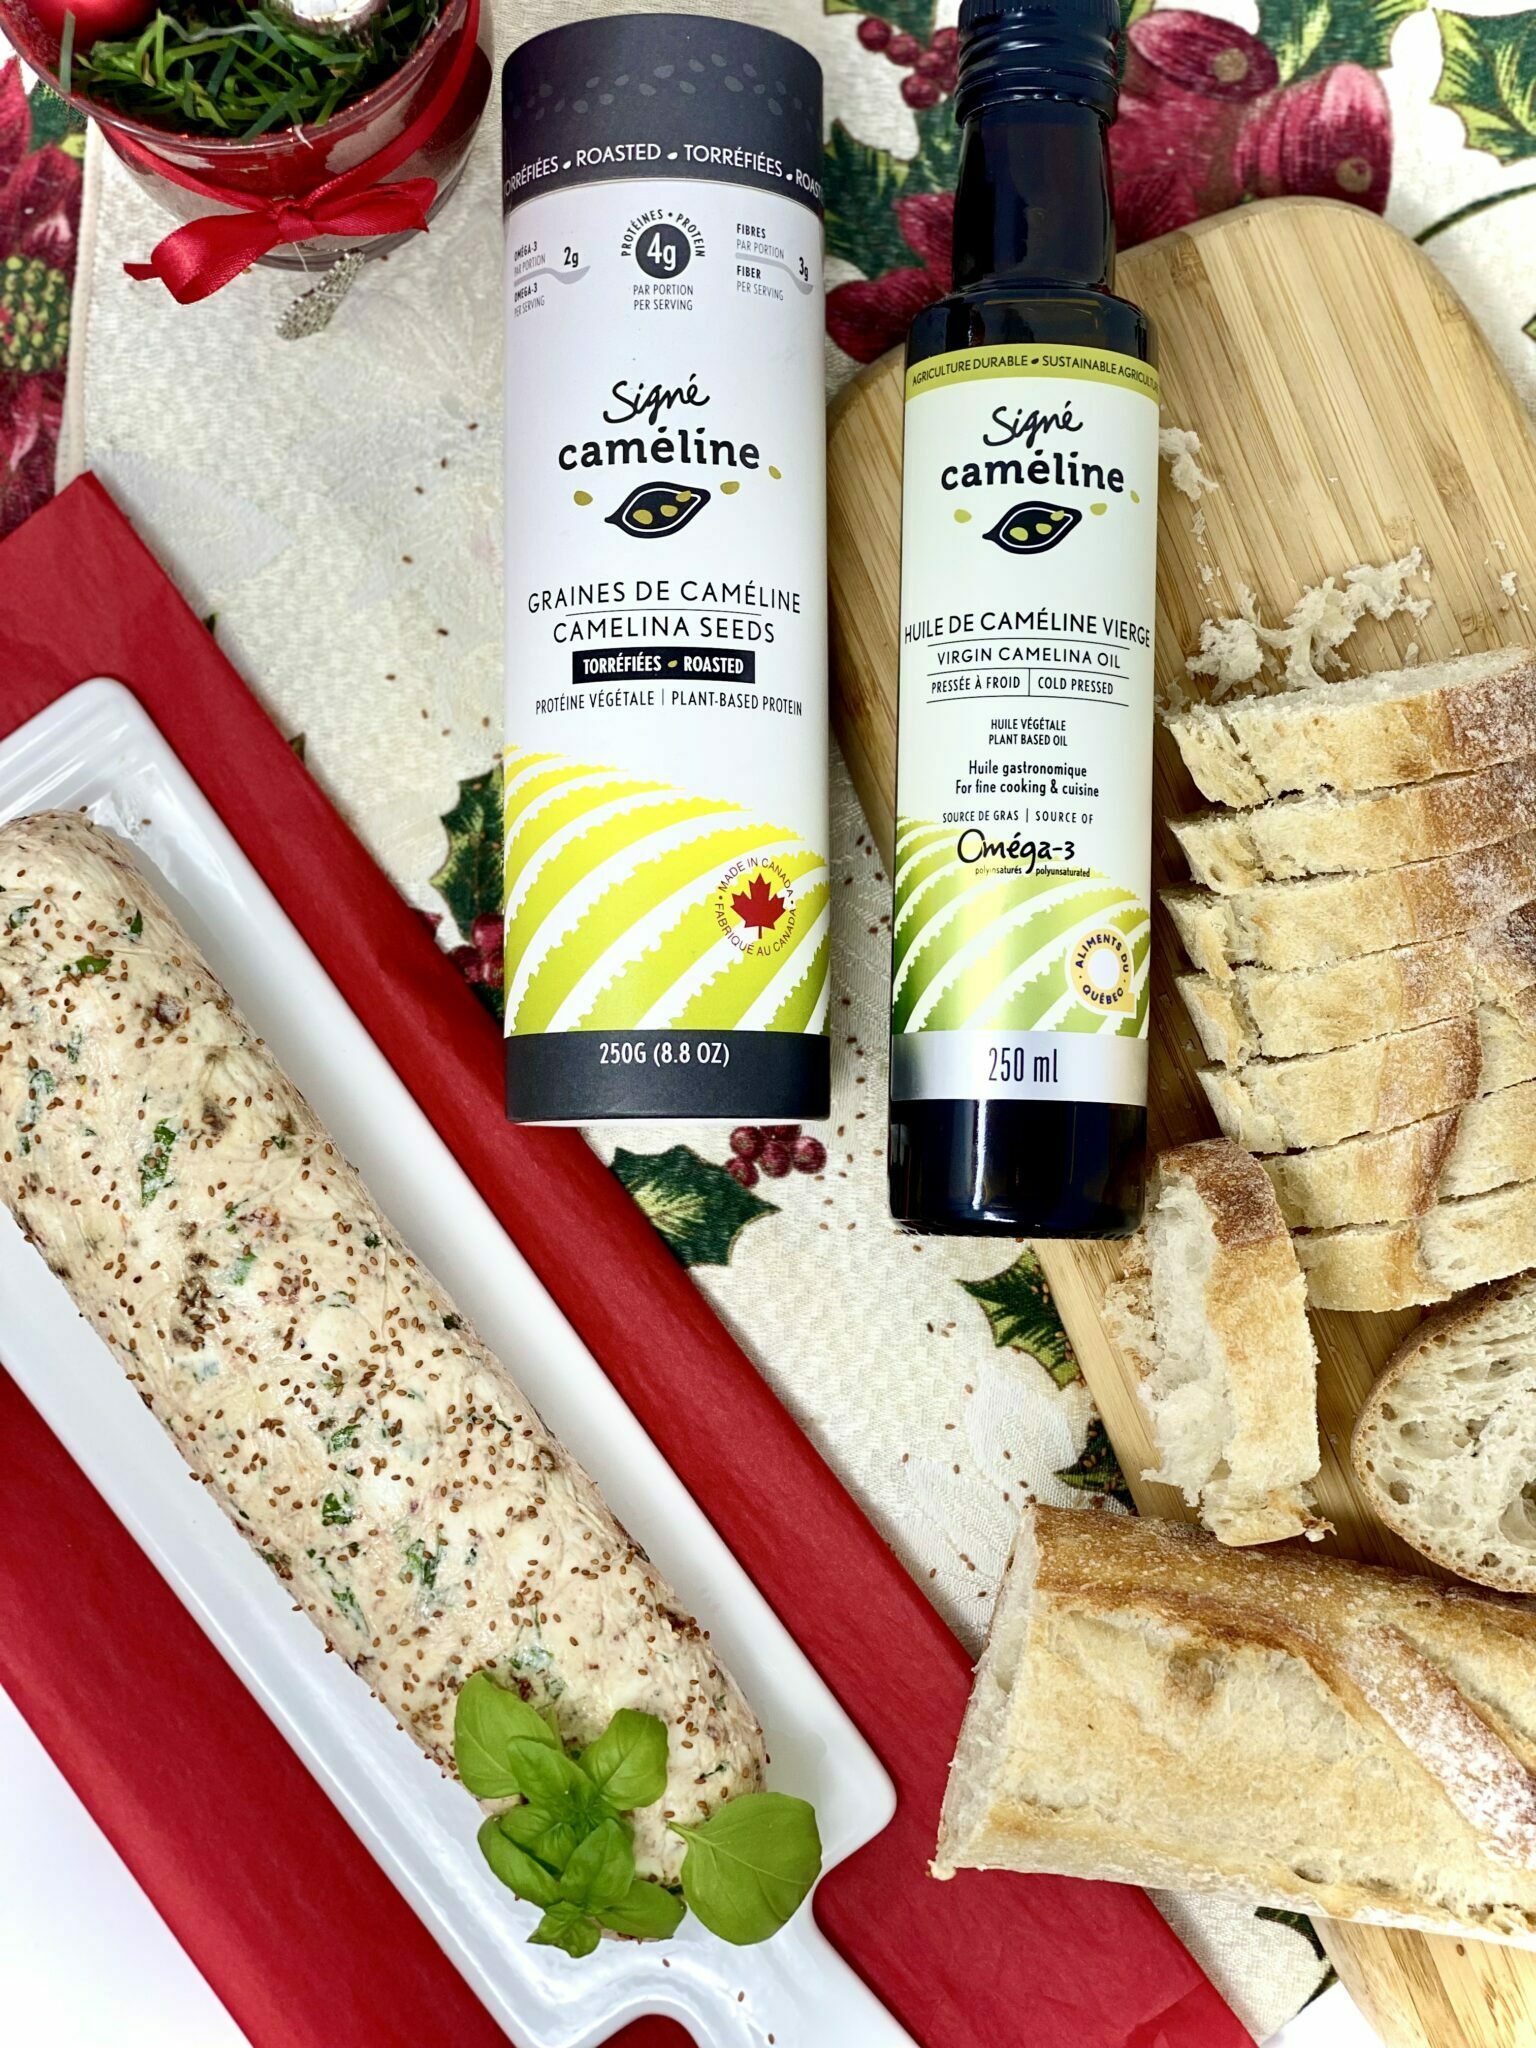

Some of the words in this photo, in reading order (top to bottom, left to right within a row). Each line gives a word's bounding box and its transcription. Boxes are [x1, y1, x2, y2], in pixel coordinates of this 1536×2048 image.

[504, 156, 559, 197] ORRÉFIÉES
[576, 143, 662, 167] ROASTED
[683, 144, 783, 178] TORRÉFIÉES
[795, 168, 822, 200] ROAST
[621, 209, 663, 257] PROTÉINES
[675, 213, 706, 257] PROTEIN
[736, 223, 766, 239] FIBRES
[564, 246, 579, 268] 2g
[646, 232, 677, 271] 4g
[736, 239, 751, 252] PAR
[753, 242, 784, 260] PORTION
[522, 254, 546, 272] PORTION
[736, 265, 761, 279] FIBER
[799, 256, 809, 281] 3g
[514, 282, 538, 302] OMEGA-3
[633, 284, 650, 295] PAR
[653, 284, 694, 295] PORTION
[736, 281, 751, 295] PER
[753, 283, 784, 301] SERVING
[522, 295, 545, 314] SERVING
[633, 299, 650, 310] PER
[653, 299, 693, 310] SERVING
[912, 359, 971, 386] AGRICULTURE
[973, 355, 1028, 370] DURABLE
[1042, 355, 1116, 375] SUSTAINABLE
[603, 373, 710, 425] Signé
[983, 400, 1083, 448] Signé
[558, 426, 760, 470] caméline
[941, 450, 1124, 492] caméline
[528, 581, 625, 613] GRAINES
[636, 581, 670, 601] DE
[680, 580, 801, 614] CAMÉLINE
[553, 616, 690, 643] CAMELINA
[700, 617, 775, 643] SEEDS
[904, 617, 943, 644] HUILE
[950, 614, 974, 634] DE
[980, 607, 1097, 634] CAMÉLINE
[1102, 617, 1150, 648] VIERGE
[583, 652, 662, 675] TORRÉFIÉES
[683, 656, 744, 675] ROASTED
[937, 648, 992, 666] VIRGIN
[999, 647, 1092, 665] CAMELINA
[1097, 652, 1121, 669] OIL
[931, 676, 971, 694] PRESSÉE
[974, 675, 982, 690] À
[986, 676, 1021, 689] FROID
[1038, 676, 1067, 690] COLD
[1071, 678, 1114, 695] PRESSED
[536, 693, 585, 715] PROTÉINE
[589, 688, 655, 708] VÉGÉTALE
[672, 690, 759, 710] PLANT-BASED
[762, 698, 802, 716] PROTEIN
[990, 718, 1018, 730] HUILE
[1020, 717, 1066, 731] VÉGÉTALE
[989, 734, 1018, 745] PLANT
[1020, 734, 1051, 746] BASED
[1053, 735, 1068, 746] OIL
[969, 760, 998, 775] Huile
[1002, 761, 1087, 779] gastronomique
[955, 780, 972, 795] For
[975, 779, 996, 793] fine
[1000, 778, 1046, 797] cooking
[1050, 779, 1059, 794] &
[1062, 782, 1100, 797] cuisine
[942, 811, 975, 823] SOURCE
[978, 811, 990, 821] DE
[993, 810, 1019, 821] GRAS
[1035, 811, 1077, 823] SOURCE
[1081, 814, 1094, 824] OF
[957, 828, 1075, 874] Oméga-3
[718, 861, 745, 892] MADE
[747, 857, 758, 868] IN
[761, 858, 794, 898] CANADA
[1035, 865, 1091, 877] polyunsaturated
[715, 903, 754, 955] FABRIQUÉ
[756, 946, 771, 956] AU
[773, 908, 796, 952] CANADA
[1075, 934, 1122, 968] ALIMENTS
[1121, 953, 1129, 973] DU
[1083, 985, 1123, 1005] QUÉBEC
[599, 1042, 647, 1064] 250G
[653, 1042, 691, 1067] (8.8
[696, 1042, 730, 1067] OZ)
[988, 1047, 1024, 1082] 250
[1034, 1048, 1058, 1082] ml
